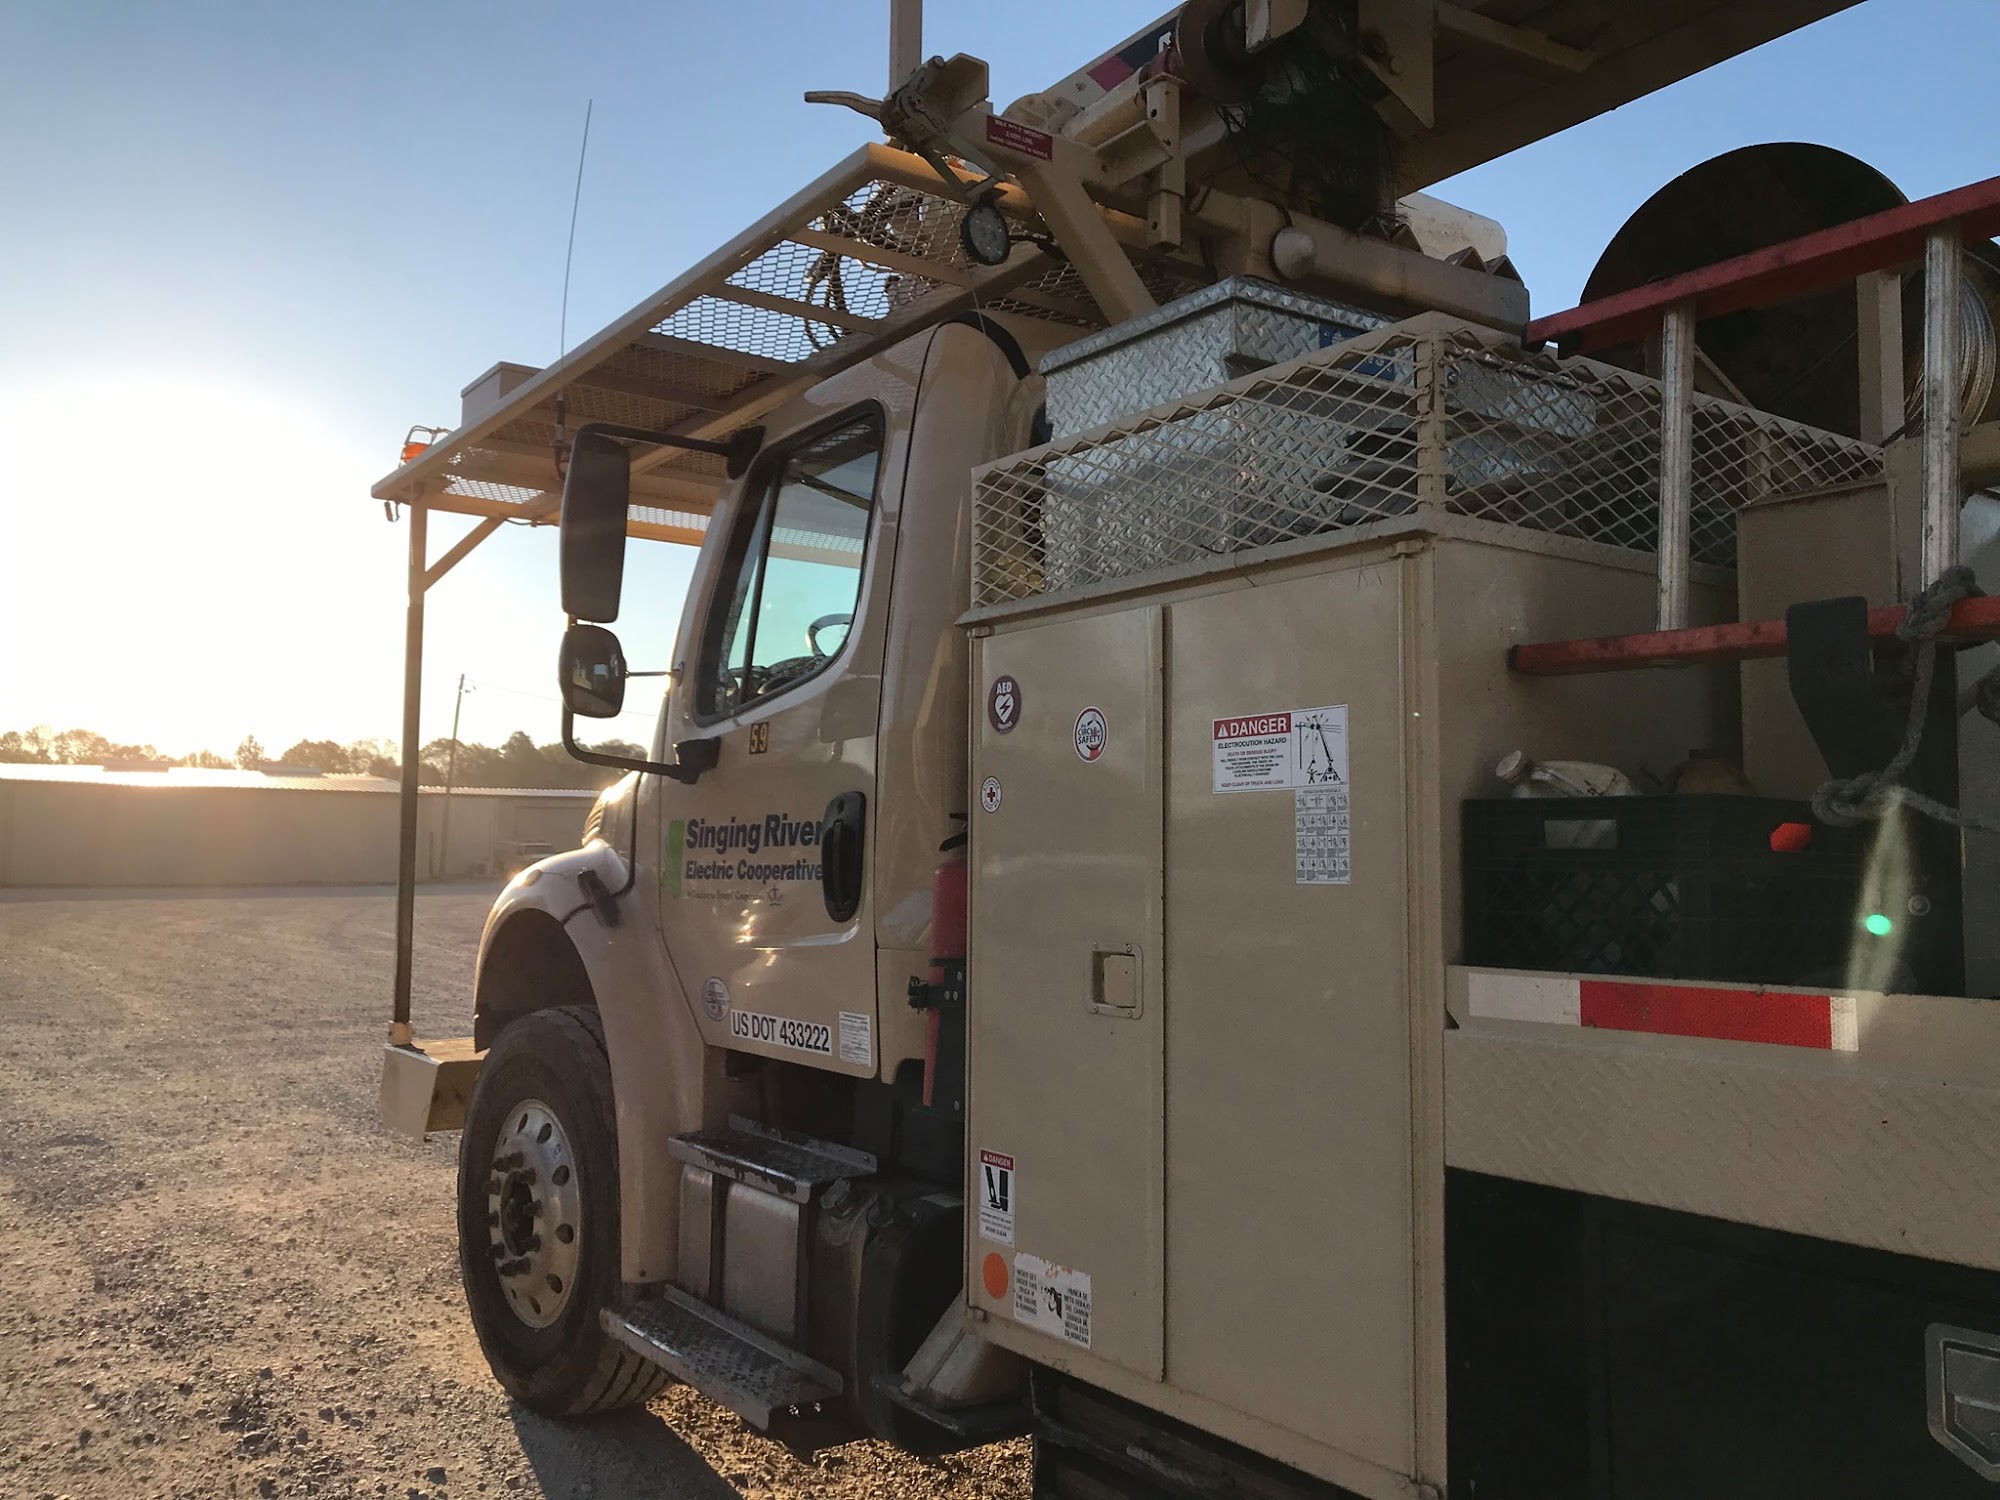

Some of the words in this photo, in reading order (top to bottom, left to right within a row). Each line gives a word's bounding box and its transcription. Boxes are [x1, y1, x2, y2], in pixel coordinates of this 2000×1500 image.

[997, 682, 1012, 694] AED
[1230, 718, 1287, 736] DANGER
[751, 723, 767, 752] 59
[1078, 735, 1100, 744] SAFETY
[1218, 740, 1262, 749] ELECTROCUTION
[686, 816, 760, 854] Singing
[764, 813, 824, 847] River
[686, 859, 733, 880] Electric
[737, 858, 823, 884] Cooperative
[732, 1011, 748, 1036] US
[751, 1015, 776, 1041] DOT
[780, 1020, 830, 1052] 433222
[988, 1154, 1011, 1167] DANGER
